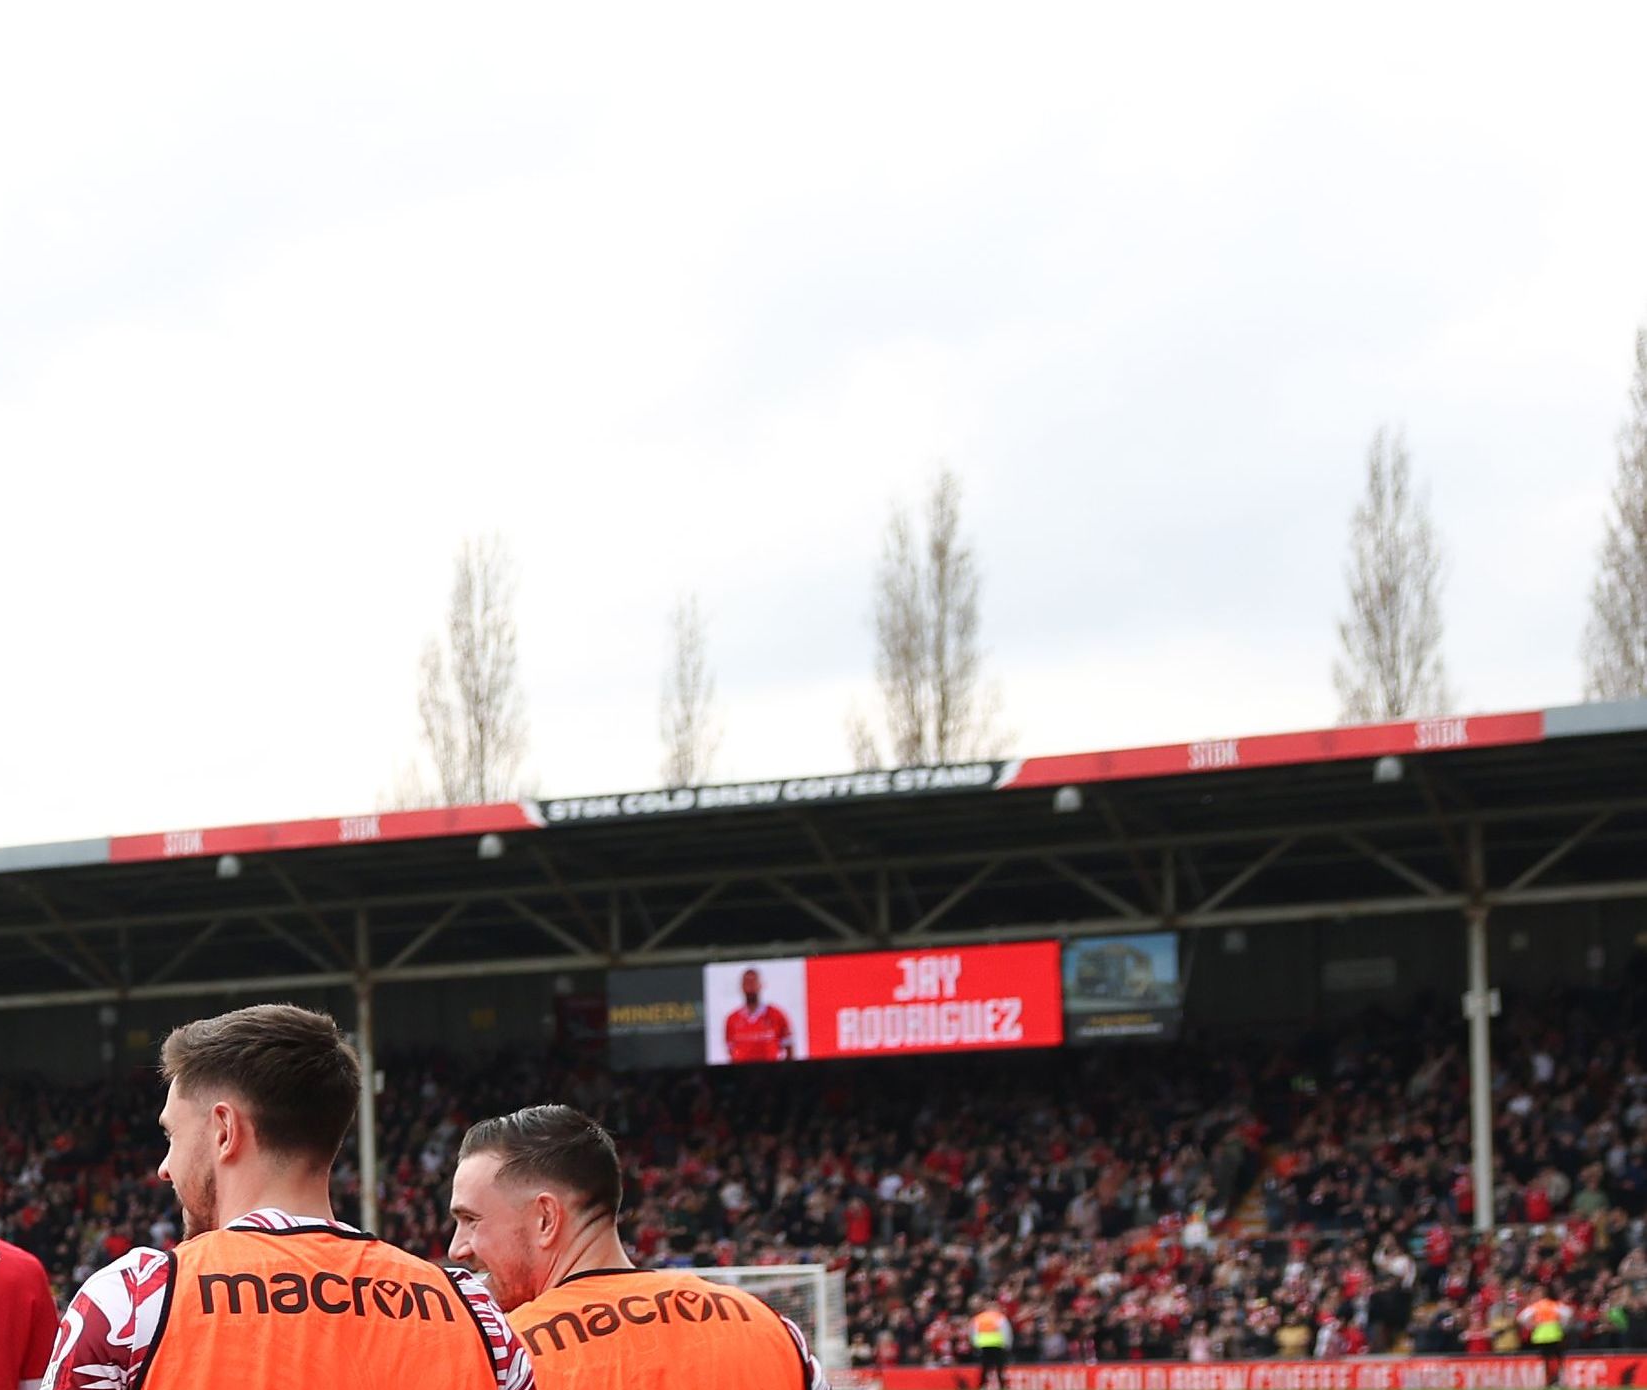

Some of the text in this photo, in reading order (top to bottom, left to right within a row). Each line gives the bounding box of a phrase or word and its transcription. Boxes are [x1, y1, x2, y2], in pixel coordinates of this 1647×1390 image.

[621, 788, 696, 815] COLD
[698, 782, 781, 809] BREW
[782, 771, 891, 800] COFFEE
[893, 763, 993, 792] STAND
[893, 954, 962, 1001] JAY
[837, 997, 1023, 1050] RODRIGUEZ
[199, 1272, 455, 1322] macron
[521, 1288, 751, 1356] macron
